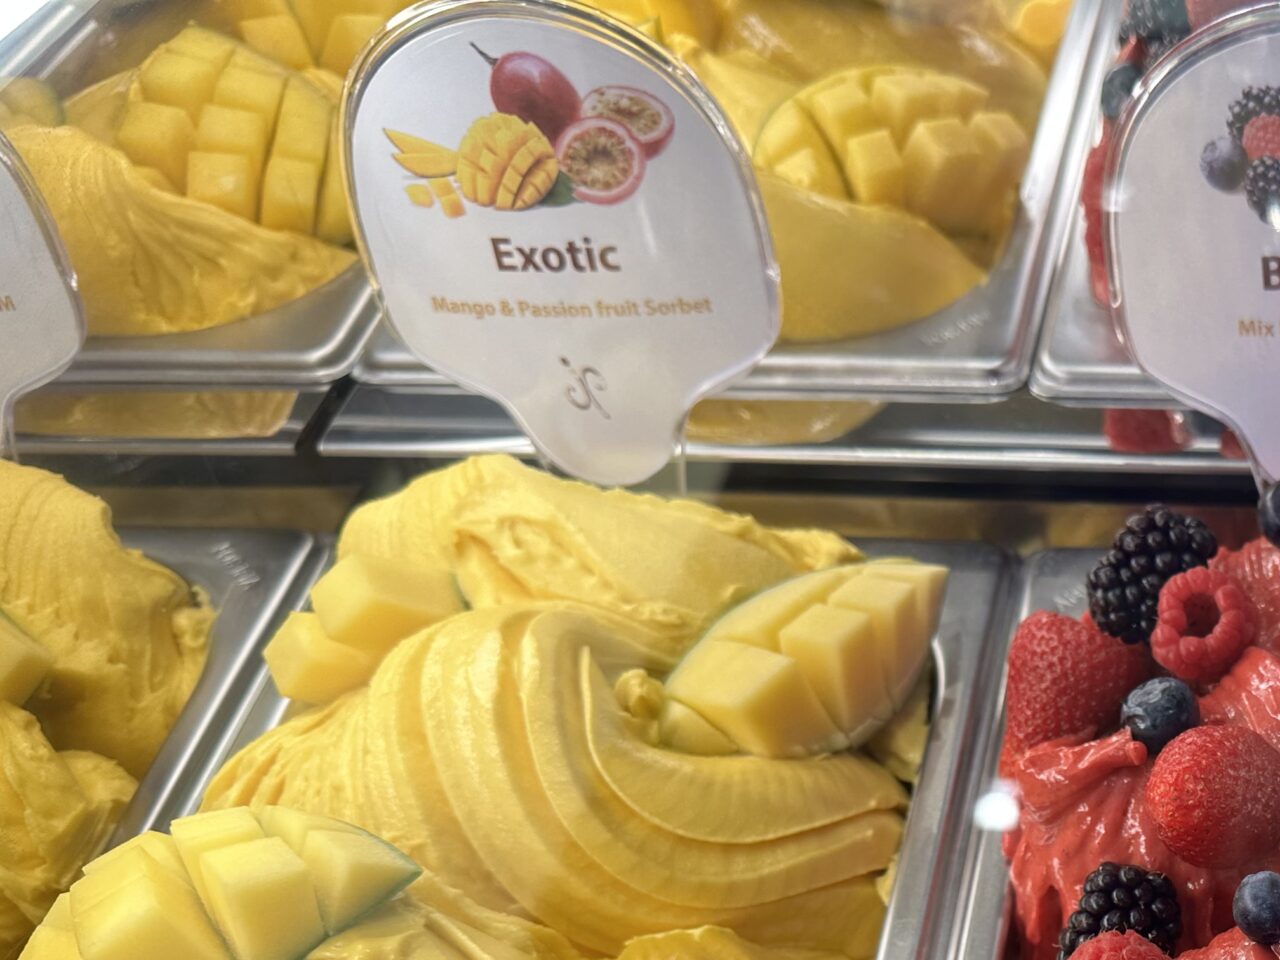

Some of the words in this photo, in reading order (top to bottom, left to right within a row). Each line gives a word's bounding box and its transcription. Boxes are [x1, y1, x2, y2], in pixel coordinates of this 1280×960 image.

[490, 236, 622, 273] Exotic
[431, 296, 496, 320] Mango
[500, 299, 515, 317] &
[518, 299, 593, 318] Passion
[643, 297, 713, 316] Sorbet
[1238, 319, 1274, 338] Mix
